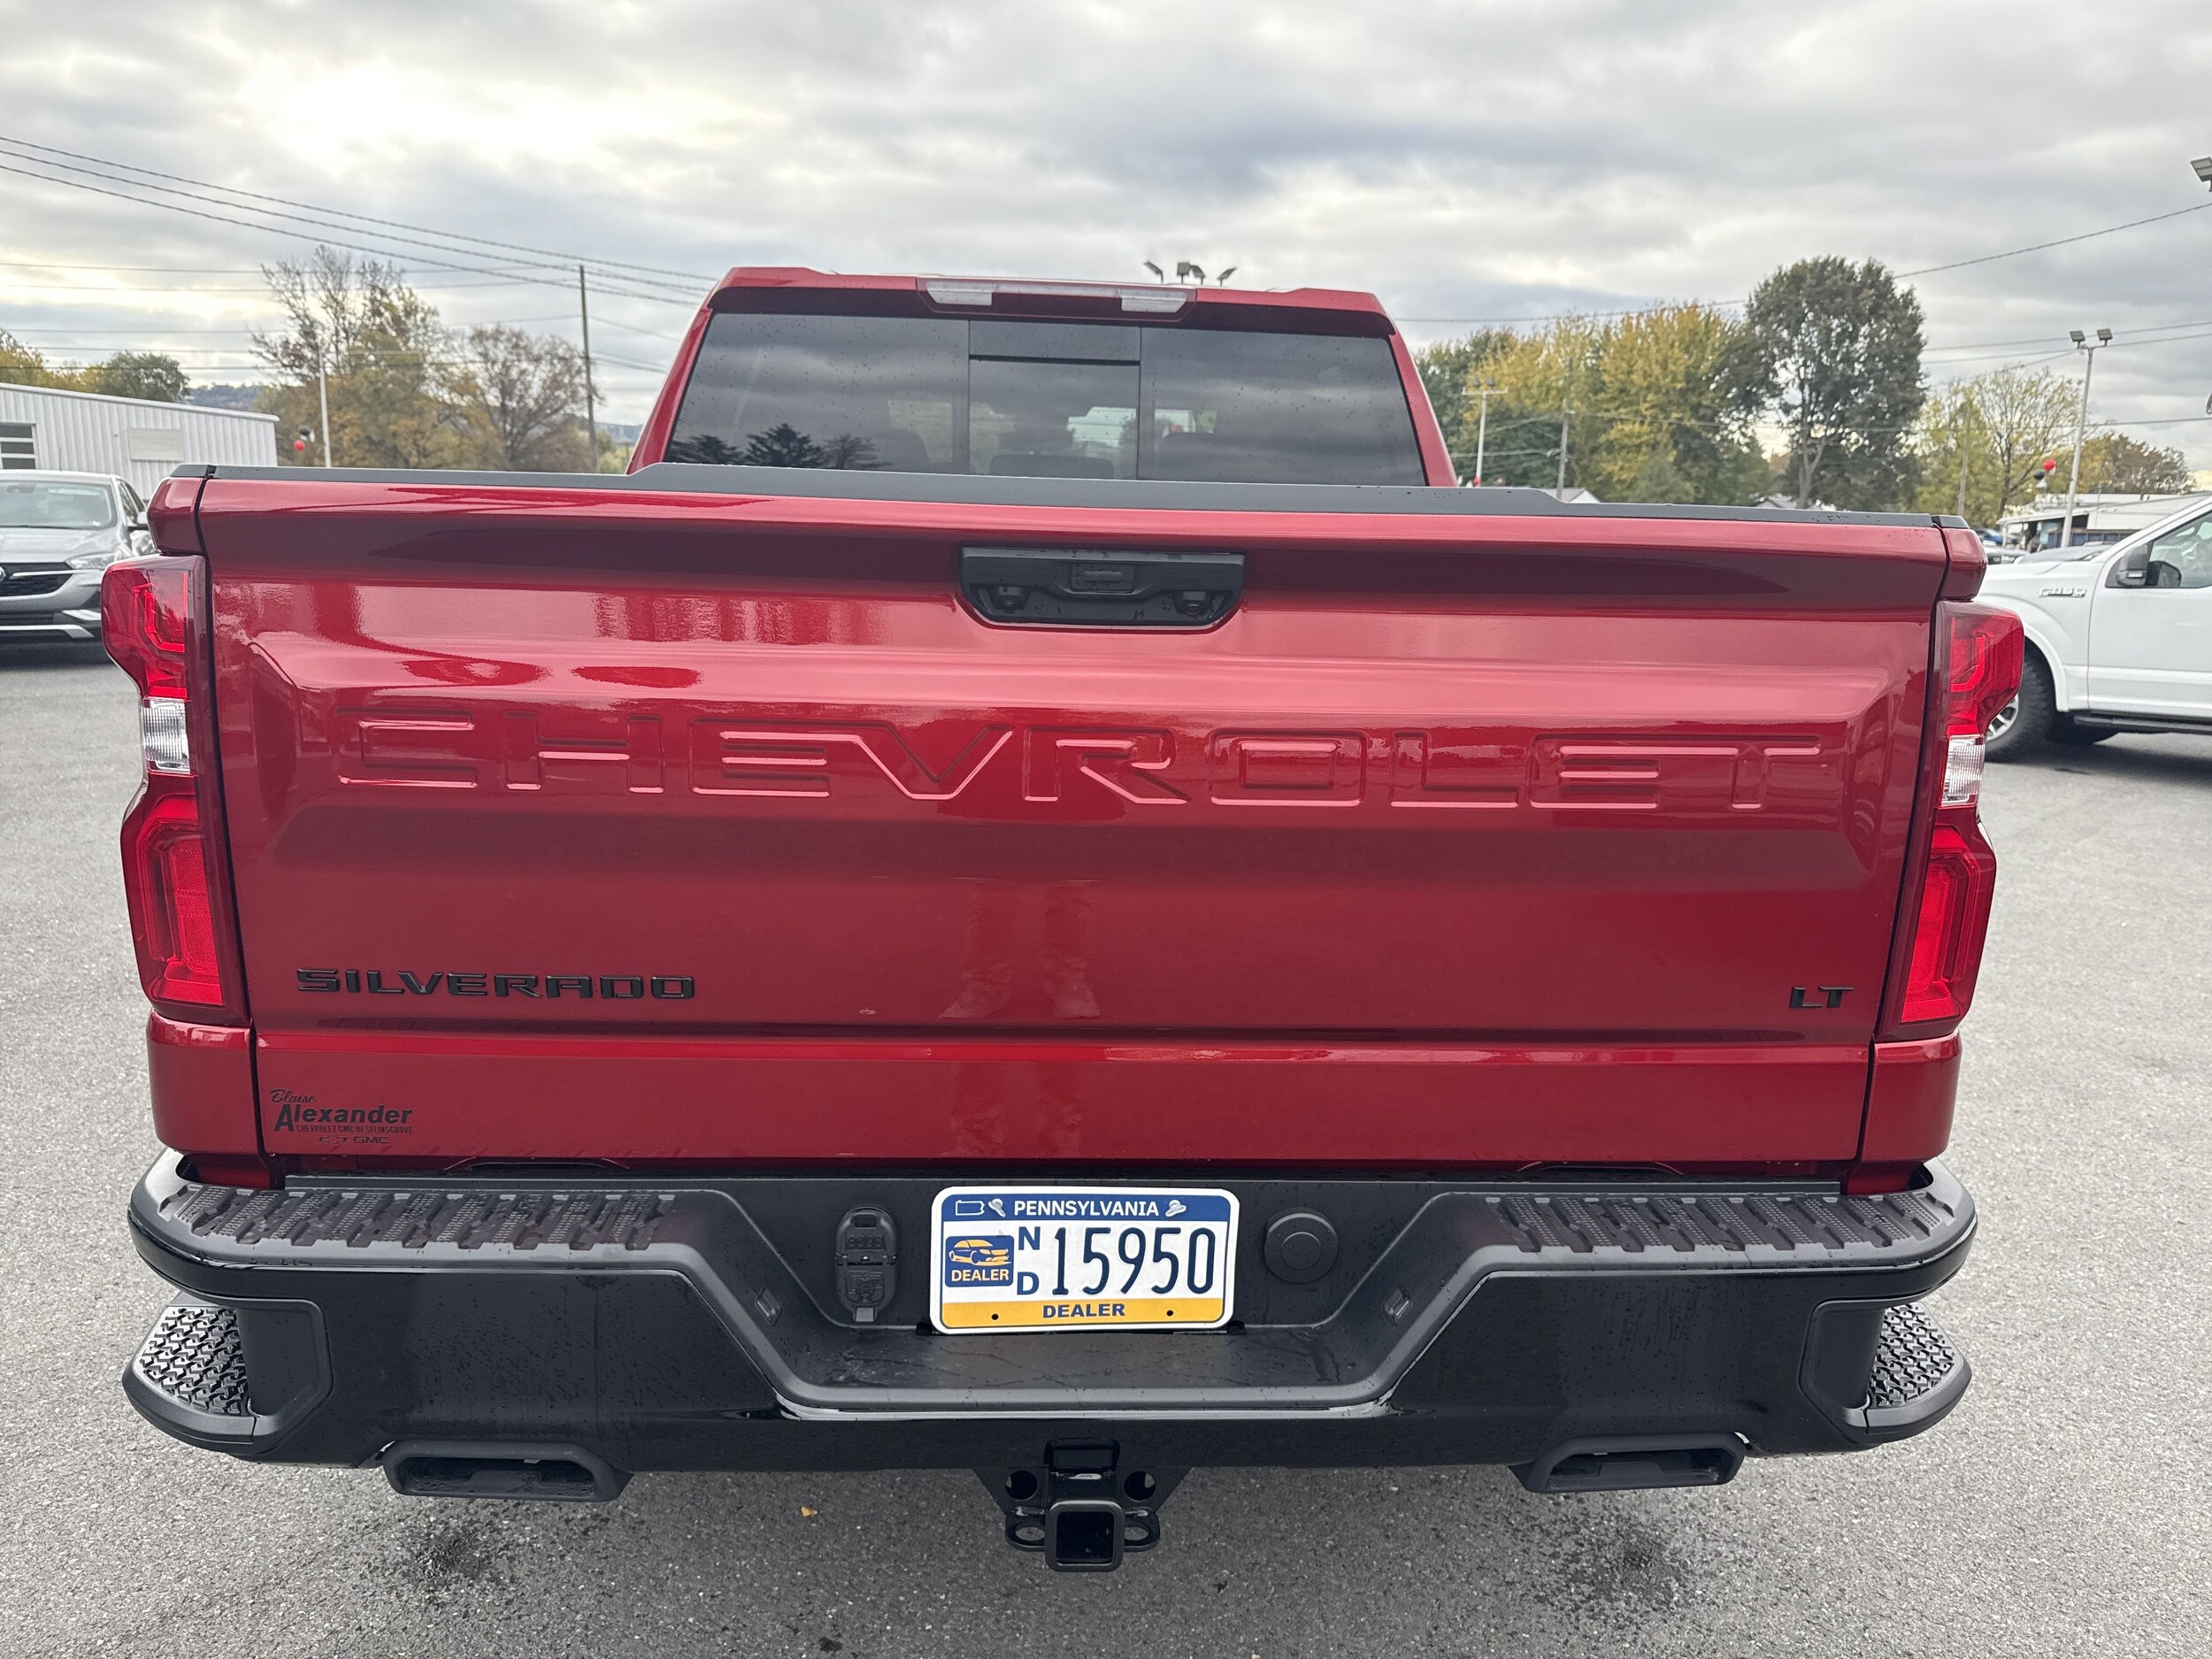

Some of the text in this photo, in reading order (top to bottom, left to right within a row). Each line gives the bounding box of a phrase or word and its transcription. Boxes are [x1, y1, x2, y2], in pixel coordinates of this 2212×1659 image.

[334, 709, 1823, 810] CHEVROLET
[296, 968, 695, 999] SILVERADO
[1789, 985, 1855, 1009] LT
[271, 1088, 316, 1103] Blaise
[273, 1104, 411, 1132] Alexander
[296, 1124, 413, 1134] CHEVROLET GMC OF SELINSGROVE
[1013, 1199, 1160, 1217] PENNSYLVANIA
[1051, 1226, 1217, 1295] 15950
[951, 1268, 1010, 1282] DEALER
[1042, 1303, 1125, 1318] DEALER
